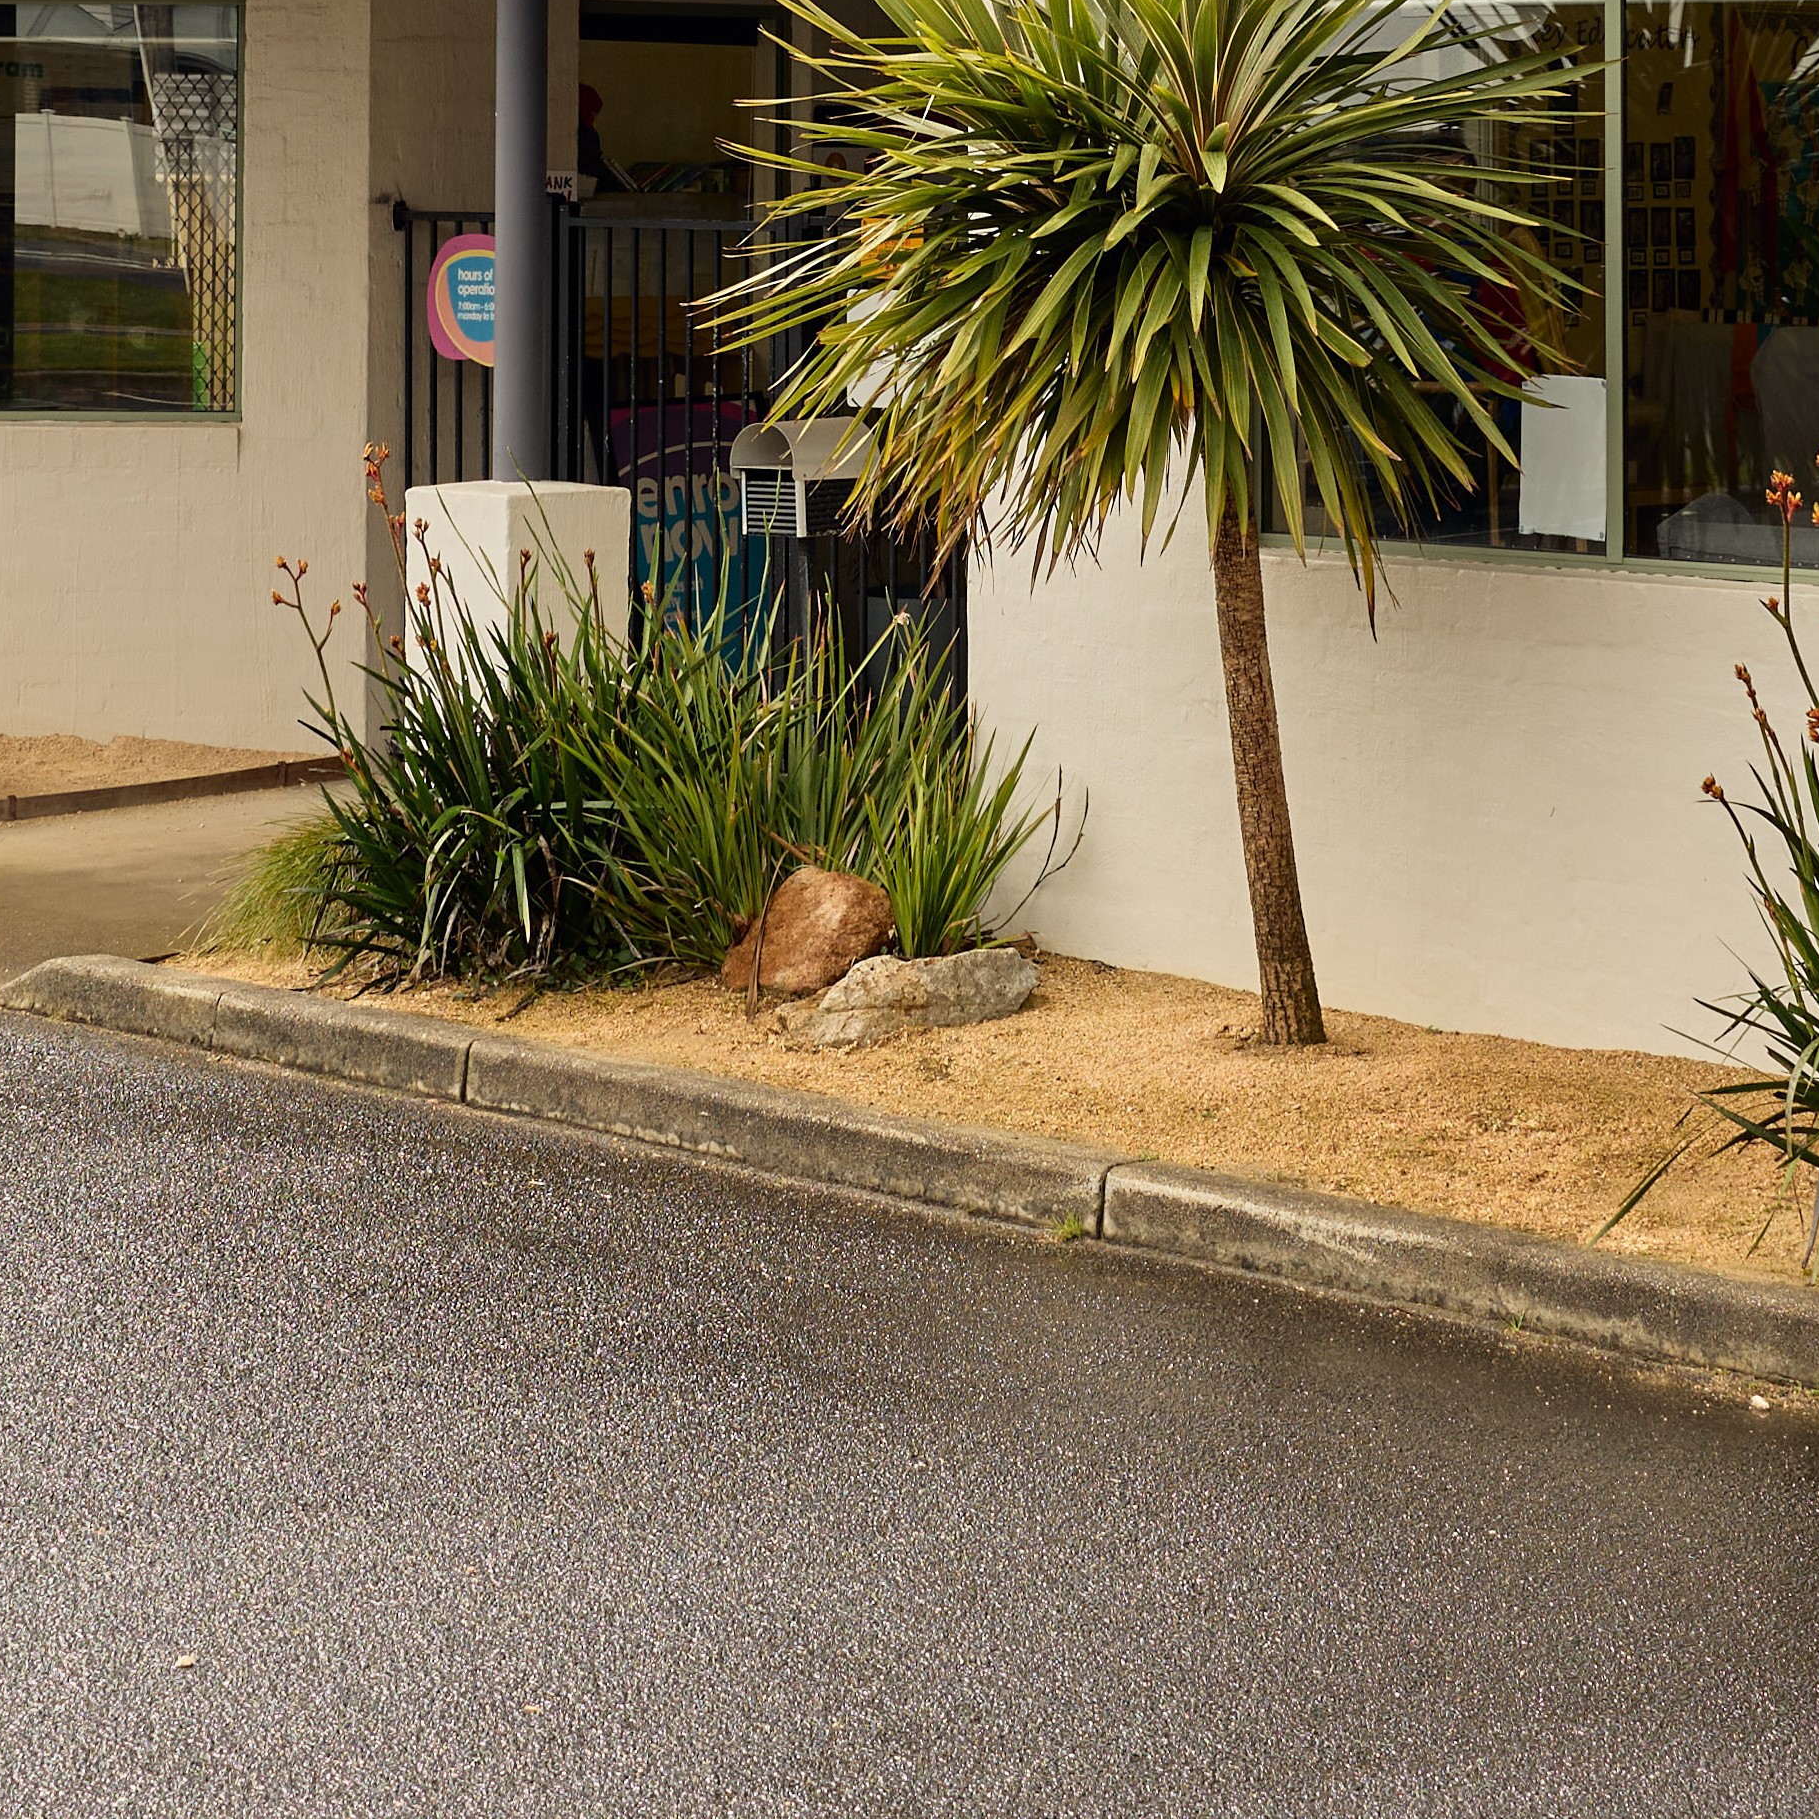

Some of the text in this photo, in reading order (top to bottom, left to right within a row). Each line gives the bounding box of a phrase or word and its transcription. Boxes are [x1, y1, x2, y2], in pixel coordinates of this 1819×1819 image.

[545, 176, 572, 189] ANK
[458, 268, 493, 281] hours of
[458, 283, 495, 297] operatio
[637, 471, 740, 518] enro
[640, 516, 739, 564] now
